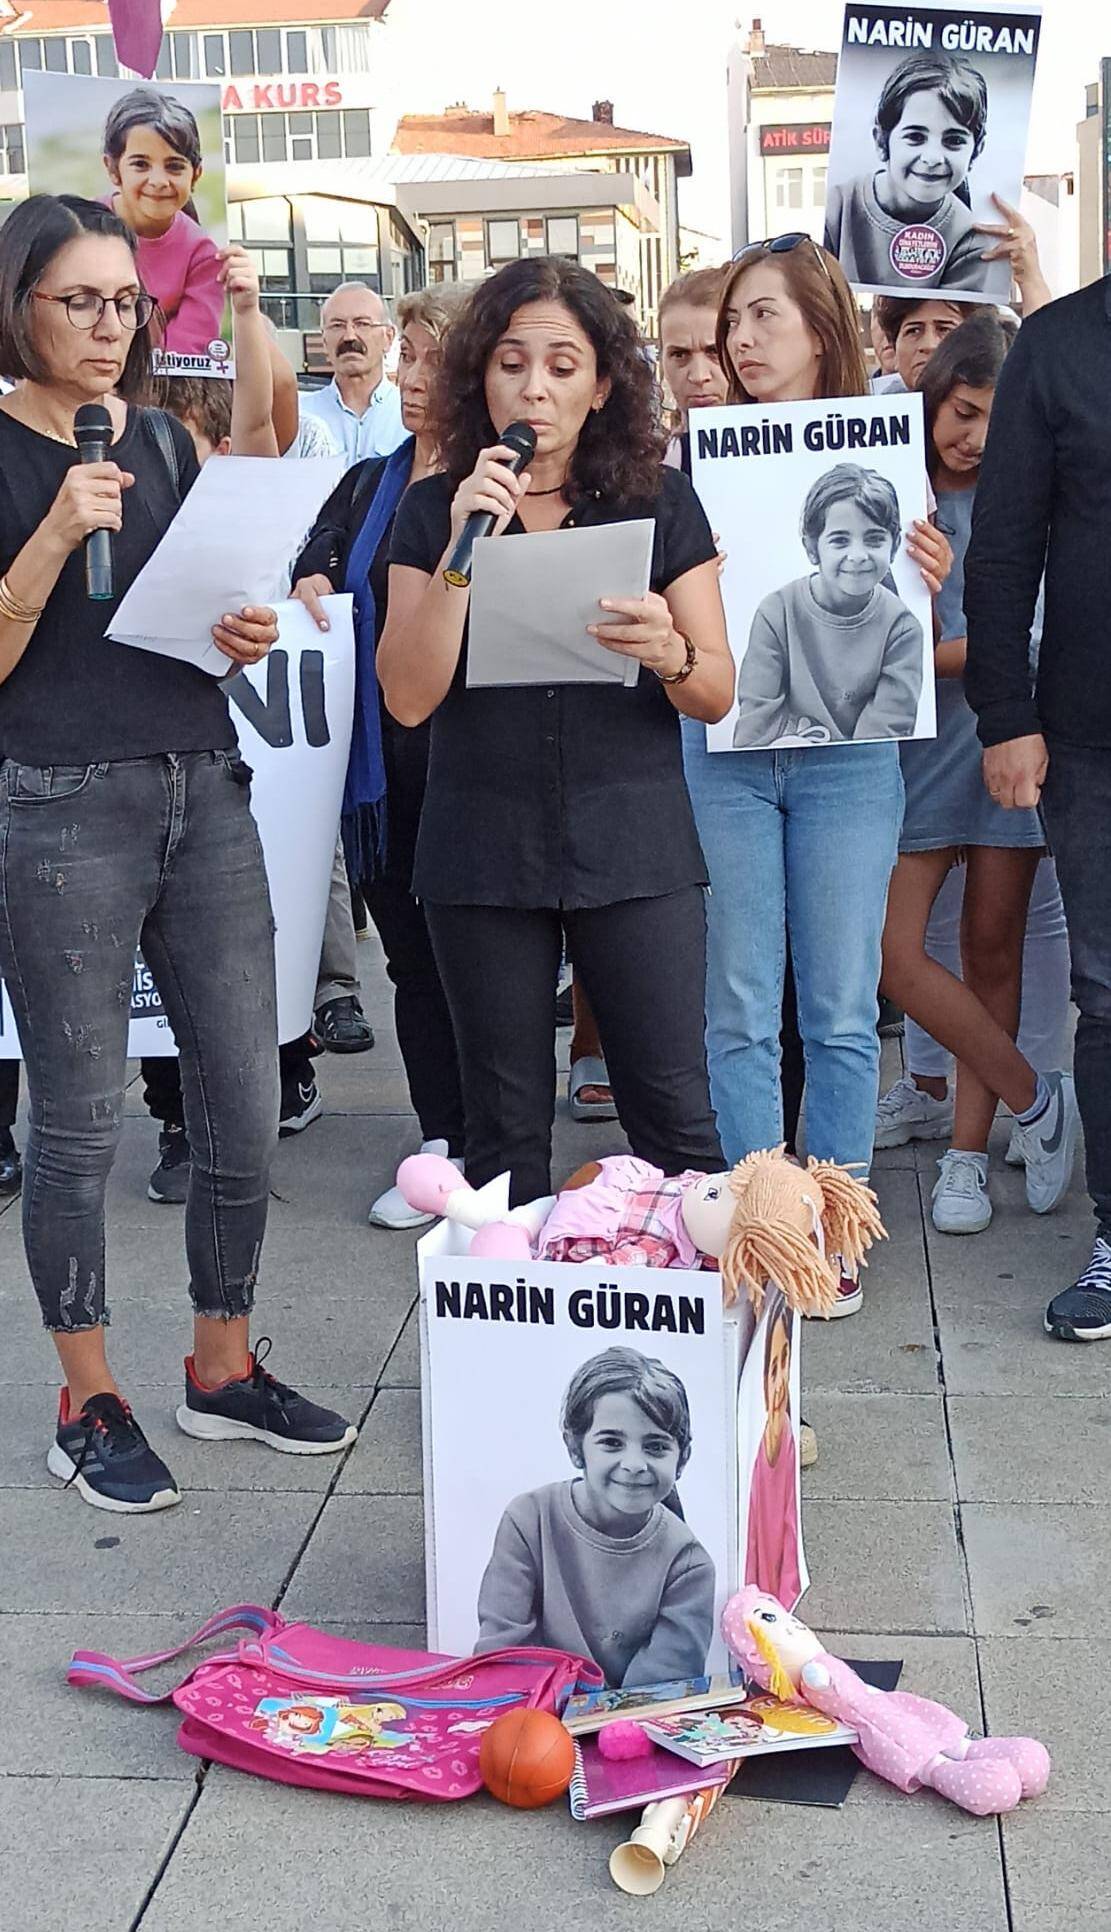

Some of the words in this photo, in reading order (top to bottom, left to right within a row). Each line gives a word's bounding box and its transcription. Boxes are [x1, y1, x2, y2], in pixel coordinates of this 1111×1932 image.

[847, 16, 933, 48] NARİN
[941, 20, 1035, 54] GÜRAN
[254, 81, 342, 108] KURS
[763, 129, 798, 148] ATİK
[904, 231, 935, 241] KADIN
[697, 419, 793, 460] NARİN
[803, 413, 910, 452] GÜRAN
[435, 1278, 554, 1325] NARİN
[568, 1283, 705, 1335] GÜRAN
